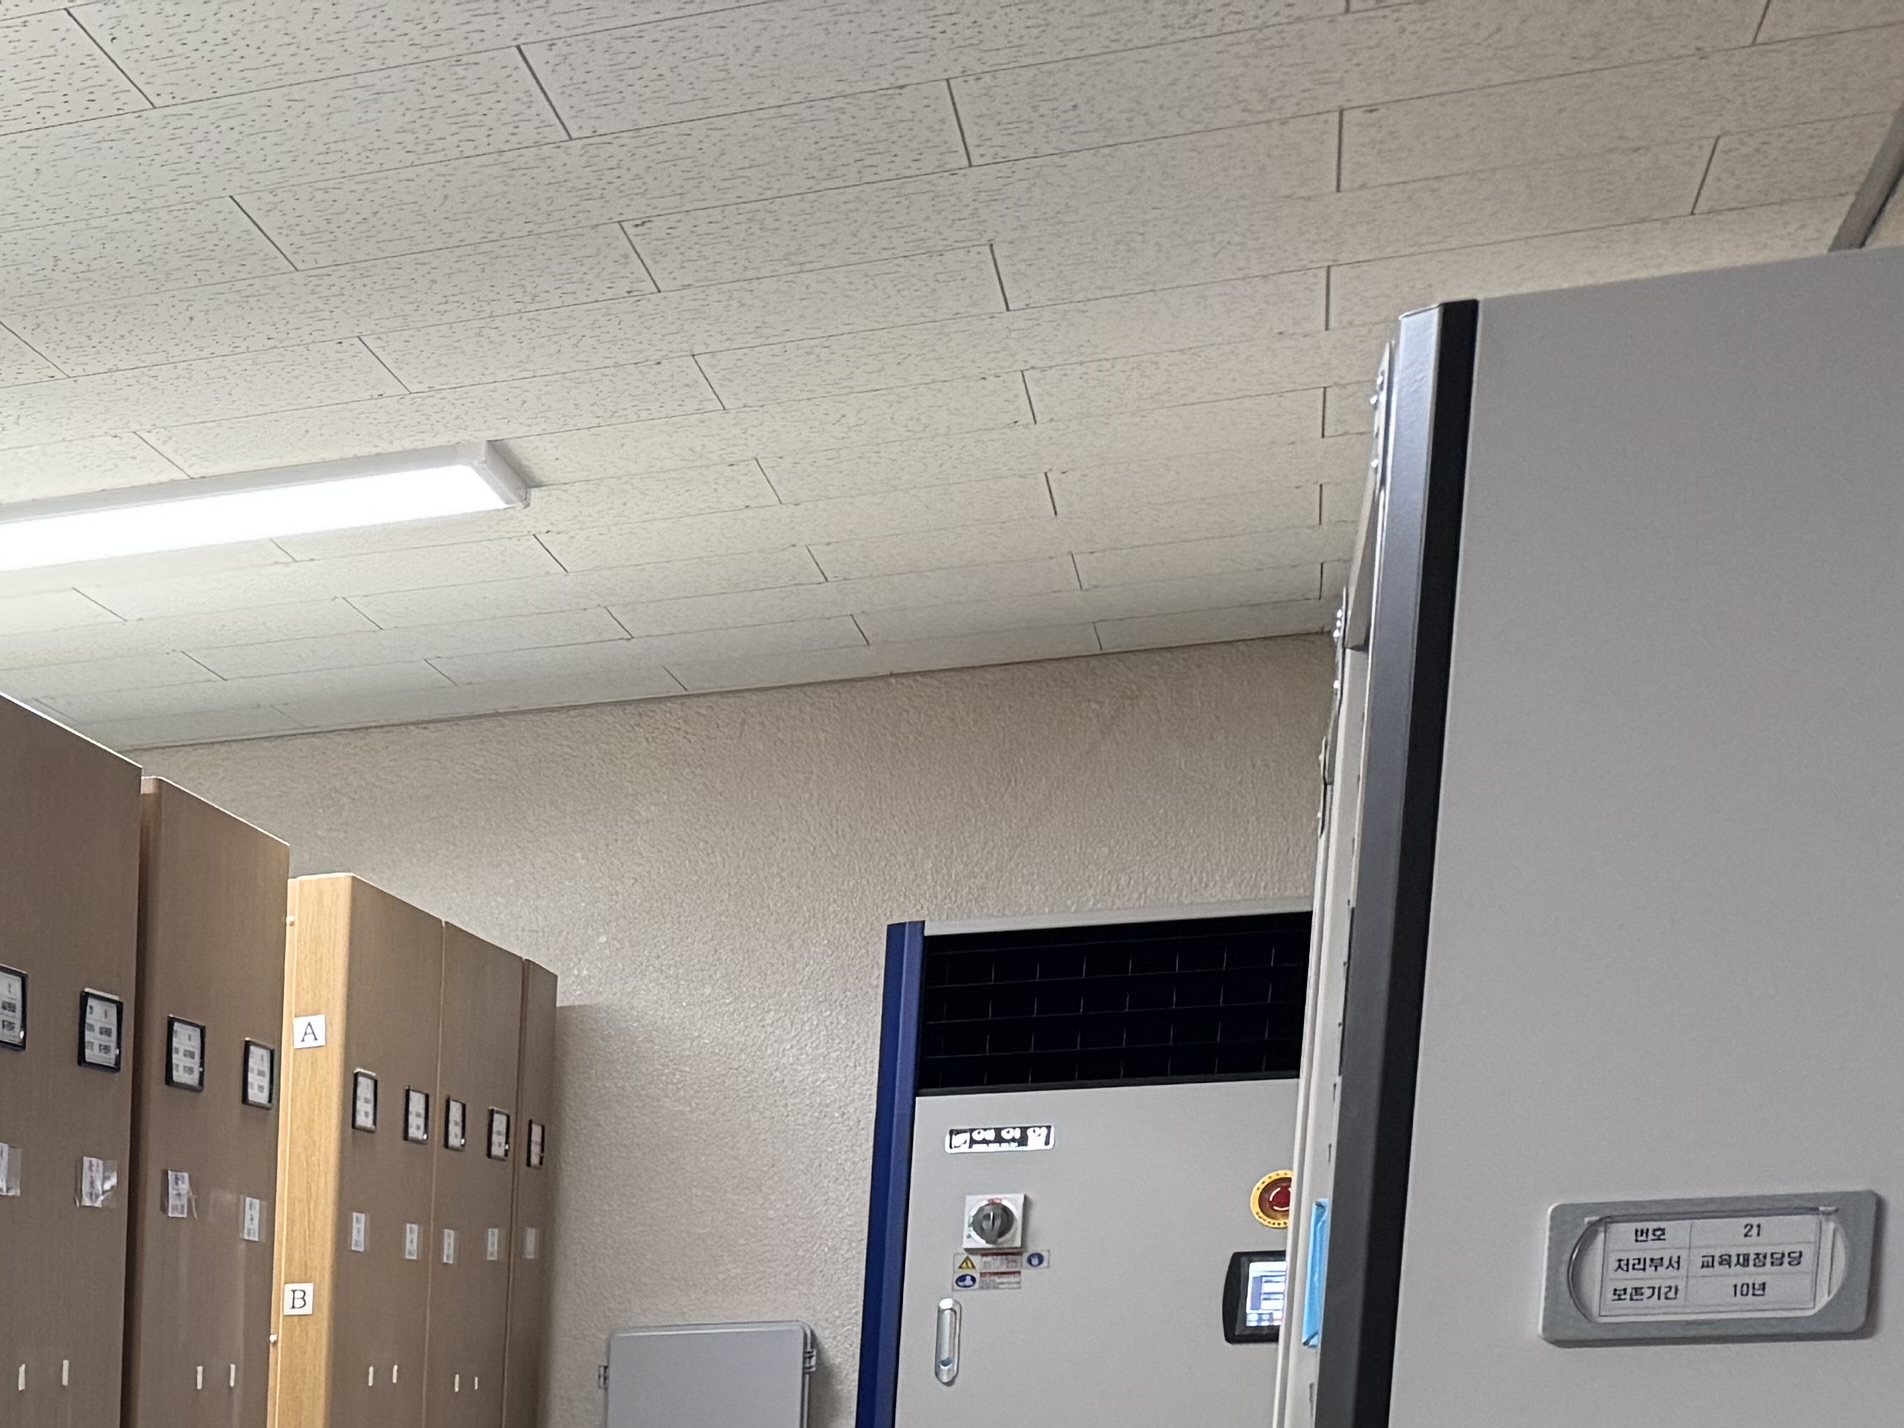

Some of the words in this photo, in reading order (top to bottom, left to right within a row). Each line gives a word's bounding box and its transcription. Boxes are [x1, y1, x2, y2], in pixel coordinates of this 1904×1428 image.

[301, 1022, 318, 1043] A
[1634, 1226, 1667, 1243] 번호
[1743, 1223, 1761, 1239] 21
[1614, 1254, 1682, 1273] 처리부서
[1700, 1250, 1803, 1270] 교육재정담당
[290, 1289, 307, 1310] B
[1611, 1284, 1679, 1302] 보존기간
[1732, 1281, 1767, 1298] 10년
